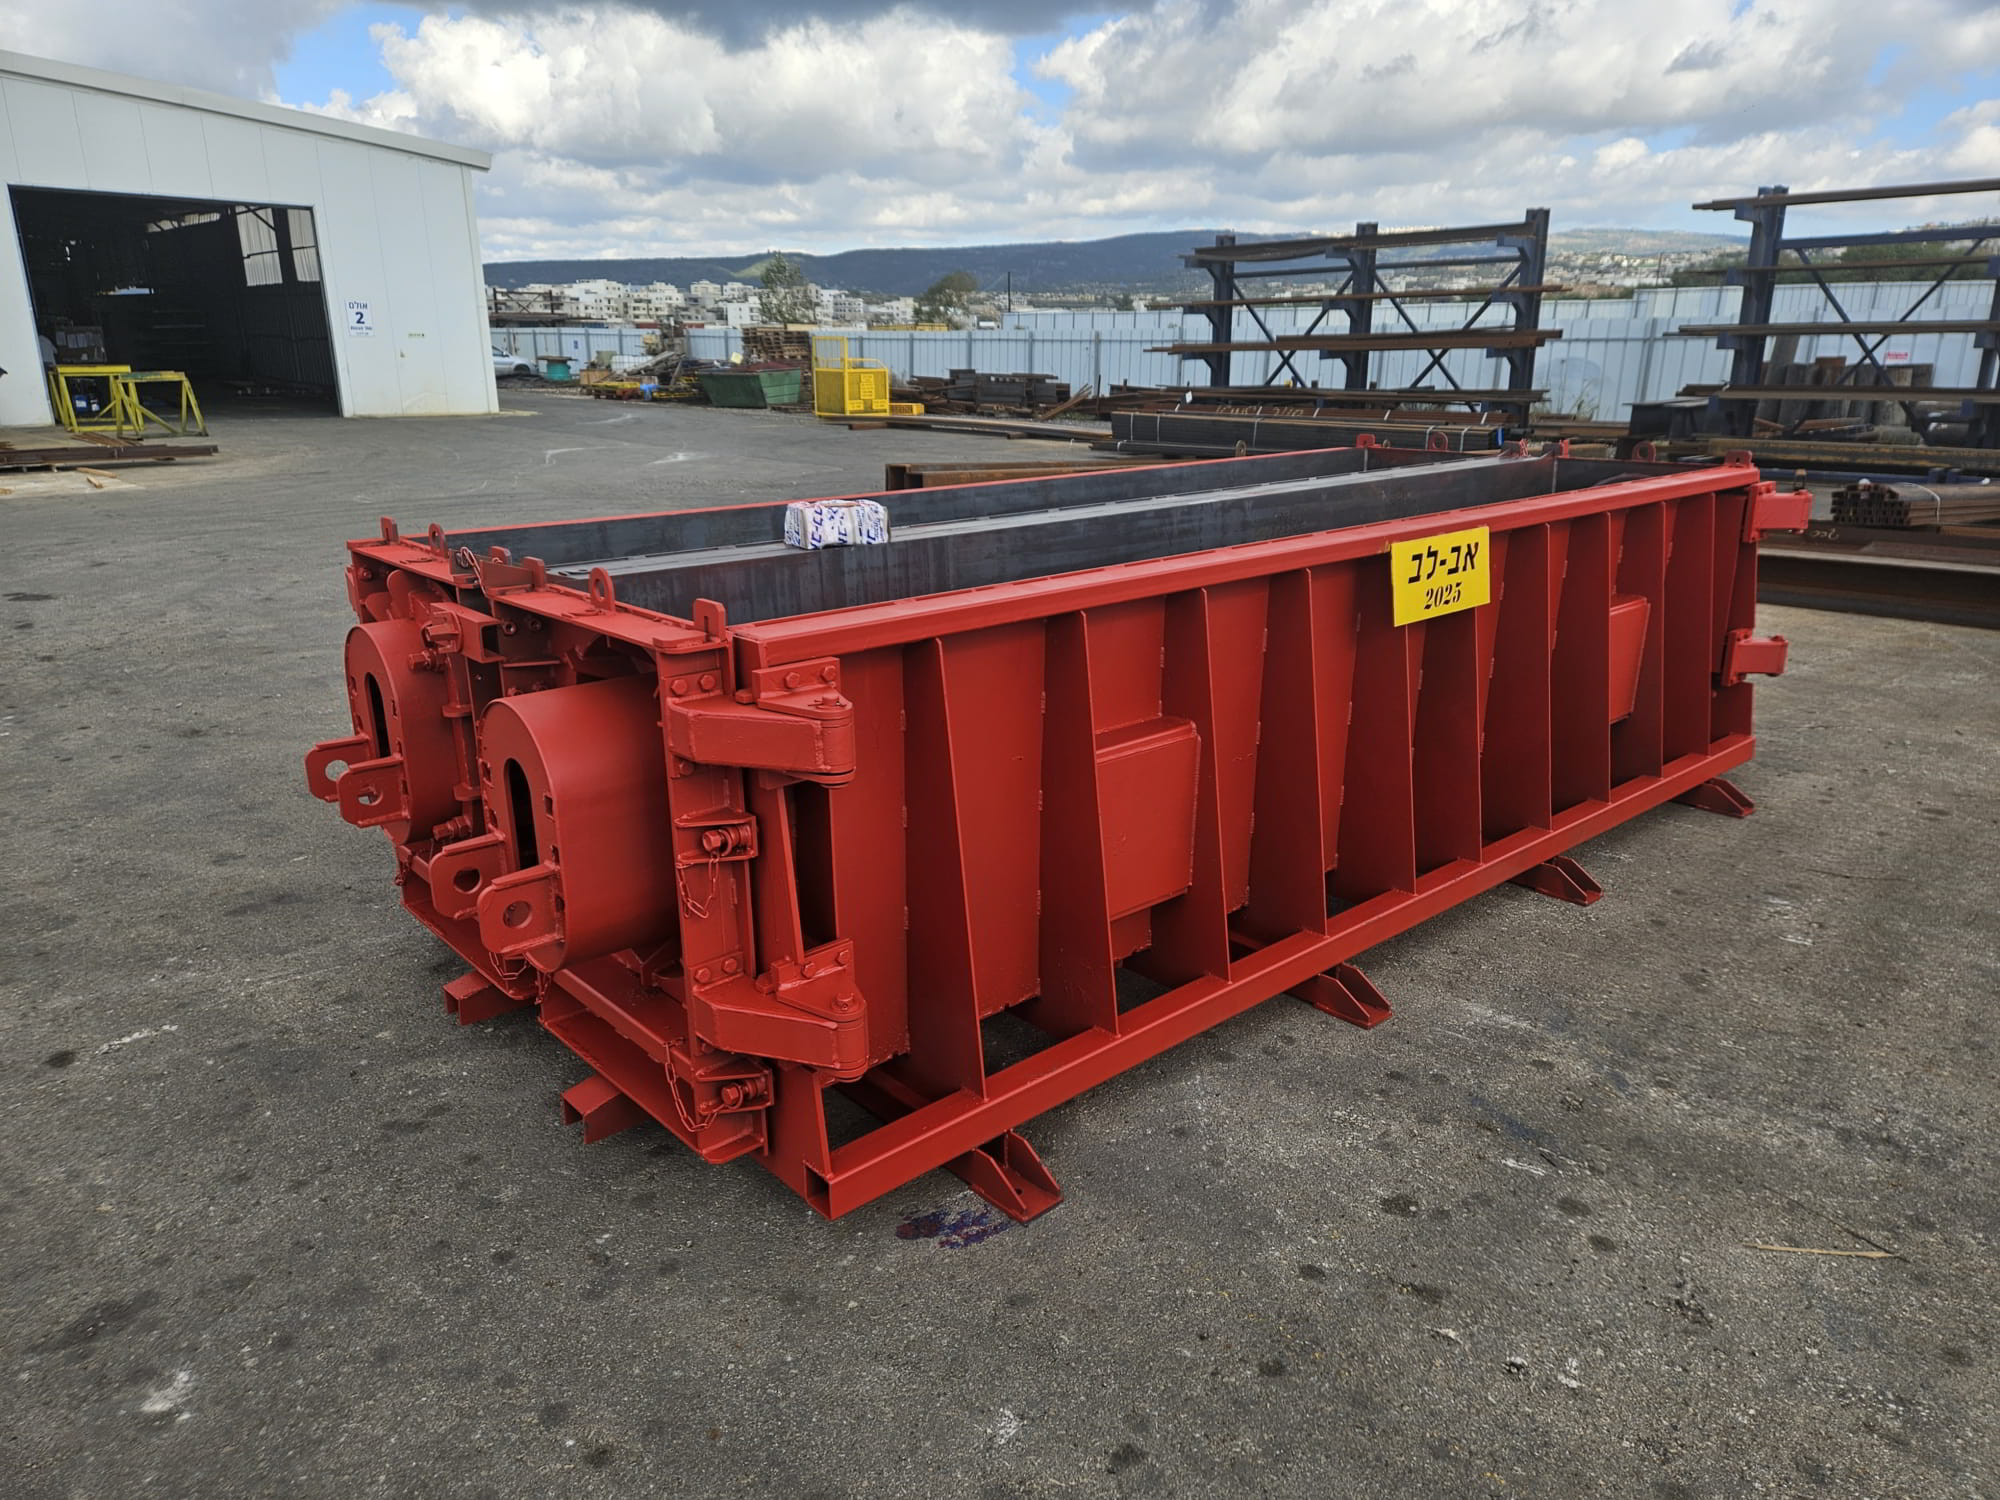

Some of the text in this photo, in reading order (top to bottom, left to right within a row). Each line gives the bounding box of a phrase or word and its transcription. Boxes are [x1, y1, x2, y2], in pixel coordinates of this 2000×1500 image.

[348, 301, 368, 310] אולם
[355, 311, 365, 324] 2
[1408, 542, 1479, 584] אב-לב
[1424, 582, 1462, 610] 2025
